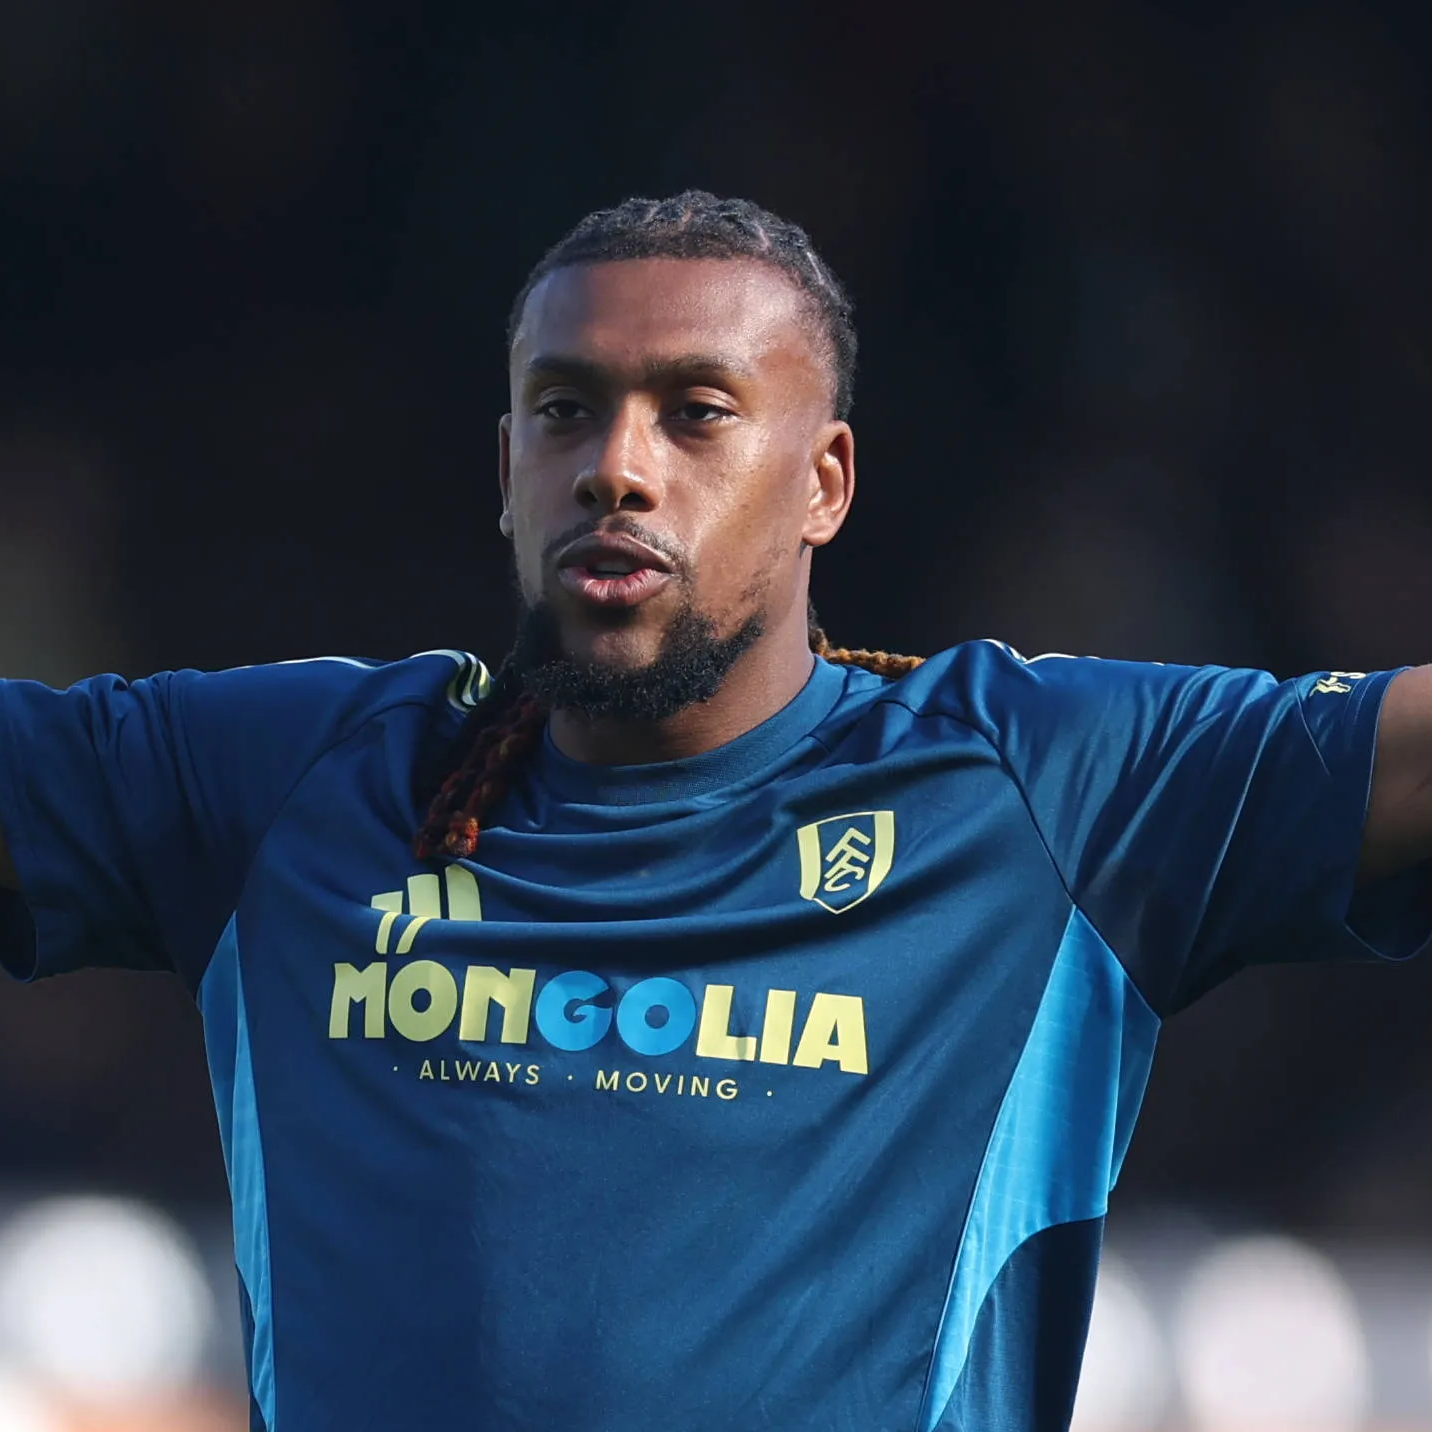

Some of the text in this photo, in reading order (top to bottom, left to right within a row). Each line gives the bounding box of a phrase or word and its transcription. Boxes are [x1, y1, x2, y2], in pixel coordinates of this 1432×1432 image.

[328, 959, 869, 1075] MONGOLIA
[419, 1057, 739, 1100] ALWAYS MOVING
